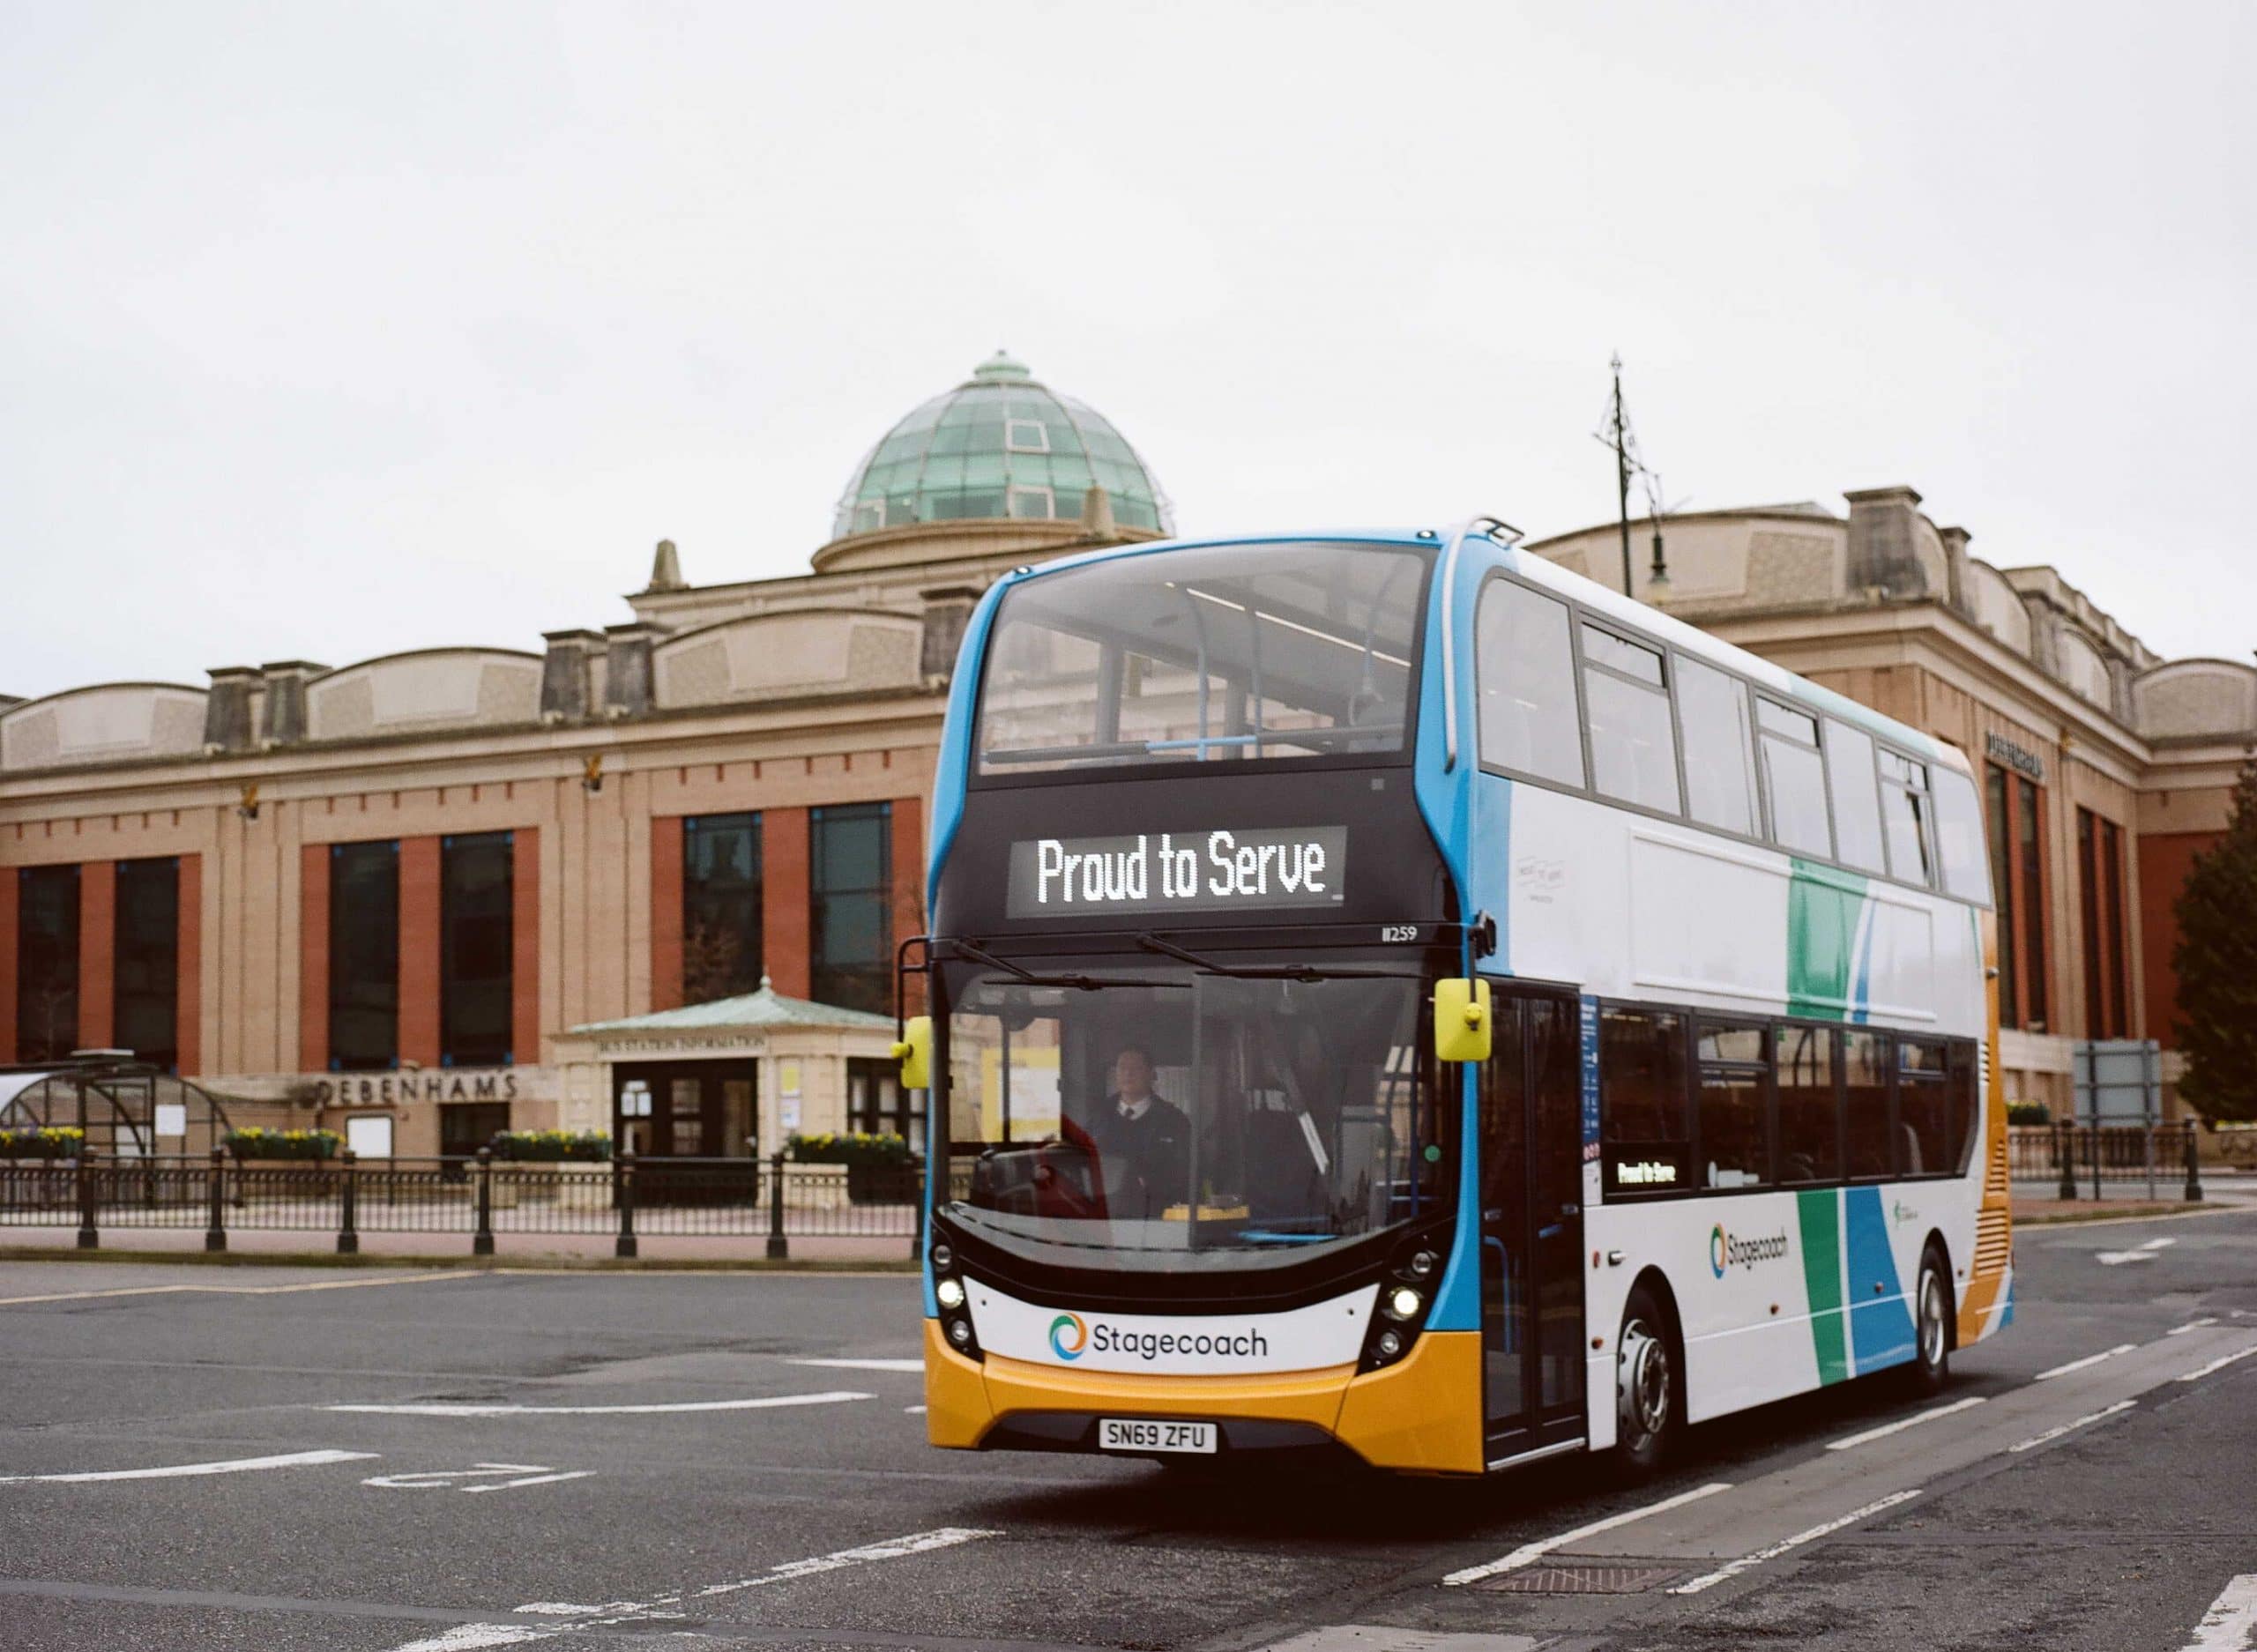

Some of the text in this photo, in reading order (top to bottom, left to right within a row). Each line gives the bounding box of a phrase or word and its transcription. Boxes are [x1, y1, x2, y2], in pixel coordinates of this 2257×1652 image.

[1038, 830, 1326, 904] Proud to Serve
[317, 1074, 518, 1103] DEBENHAMS
[1728, 1226, 1788, 1271] Stagecoach
[1093, 1324, 1268, 1360] Stagecoach
[1107, 1424, 1205, 1447] SN69 ZFU
